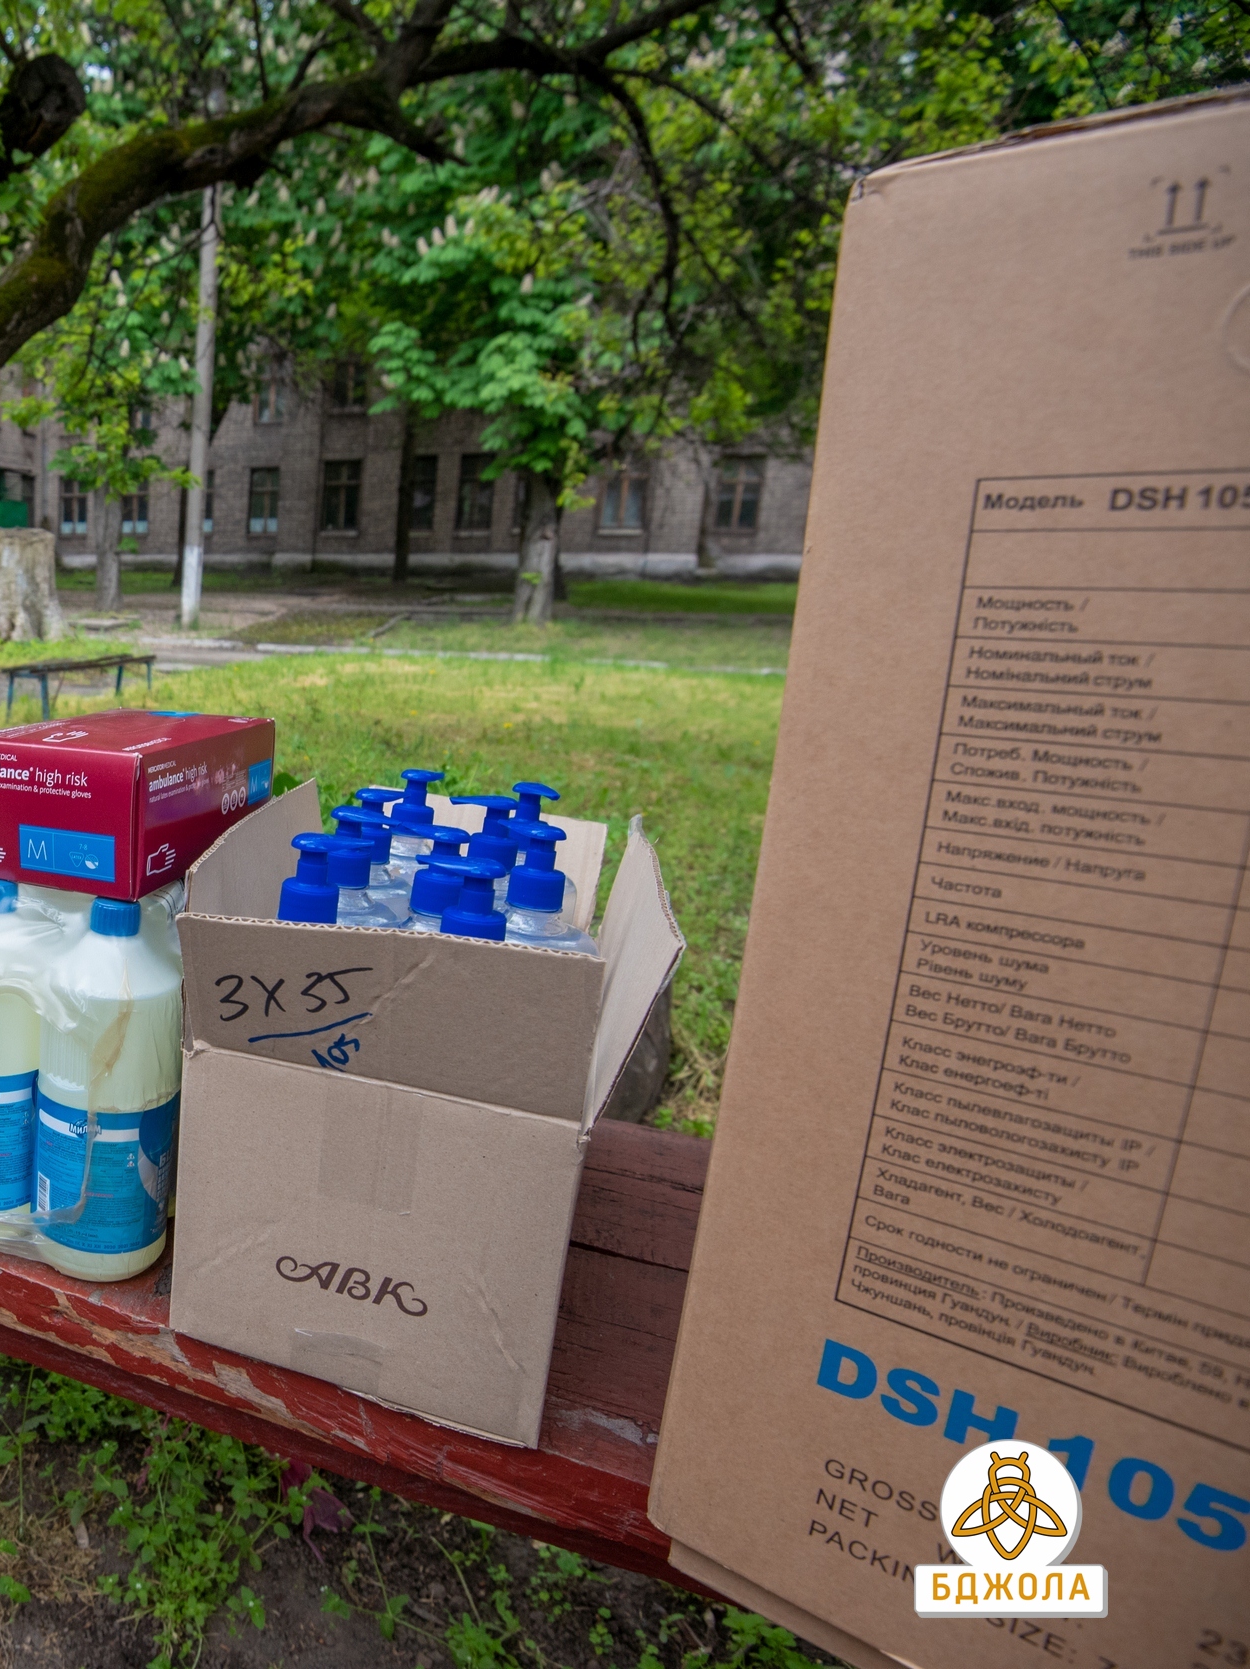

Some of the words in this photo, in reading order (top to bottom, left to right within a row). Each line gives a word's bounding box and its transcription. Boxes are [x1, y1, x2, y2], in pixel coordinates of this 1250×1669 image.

[982, 491, 1084, 512] Модель
[1109, 485, 1189, 511] DSH
[976, 596, 1075, 612] Мощность
[972, 616, 1079, 635] Потужність
[968, 646, 1103, 665] Номинальный
[1108, 653, 1140, 666] ток
[965, 666, 1090, 686] Номінальний
[1092, 675, 1153, 691] струм
[961, 695, 1105, 717] Максимальный
[1110, 706, 1142, 720] ток
[957, 716, 1099, 738] Максимальний
[1102, 728, 1163, 746] струм
[1032, 749, 1134, 771] Мощность
[35, 768, 62, 787] high
[65, 771, 88, 787] risk
[185, 765, 198, 784] high
[251, 775, 258, 794] M
[1032, 770, 1143, 794] Потужність
[33, 785, 39, 793] &
[39, 786, 71, 798] protective
[71, 789, 92, 800] gloves
[1051, 805, 1151, 826] мощность
[1040, 823, 1146, 847] потужність
[27, 838, 48, 862] M
[937, 841, 1050, 868] Напряжение
[1064, 858, 1147, 881] Напруга
[930, 875, 1003, 899] Частота
[924, 911, 961, 929] LRA
[965, 921, 1086, 950] компрессора
[919, 939, 993, 964] Уровень
[998, 953, 1050, 974] шума
[916, 957, 974, 980] Рівень
[978, 971, 1029, 992] шуму
[908, 984, 942, 1001] Вес
[1009, 1005, 1053, 1026] Вага
[1058, 1015, 1117, 1039] Нетто
[901, 1036, 952, 1058] Класс
[904, 1004, 939, 1022] Вес
[1014, 1027, 1058, 1049] Вага
[1063, 1038, 1132, 1065] Брутто
[898, 1054, 940, 1074] Клас
[893, 1081, 943, 1103] Класс
[1119, 1138, 1144, 1152] IP
[890, 1099, 930, 1119] Клас
[1117, 1157, 1140, 1172] IP
[884, 1125, 933, 1149] Класс
[937, 1142, 1076, 1188] электрозащиты
[881, 1142, 921, 1164] Клас
[925, 1159, 1063, 1206] електрозахисту
[873, 1184, 912, 1206] Вага
[970, 1195, 1005, 1216] Вес
[852, 1264, 937, 1301] провинция
[864, 1214, 905, 1238] Срок
[908, 1229, 983, 1263] годности
[988, 1254, 1010, 1271] не
[1122, 1296, 1190, 1329] Термін
[938, 1310, 1017, 1347] провінція
[816, 1338, 1019, 1445] DSH
[1047, 1435, 1250, 1551] 105
[824, 1458, 939, 1522] GROSS
[816, 1488, 879, 1528] NET
